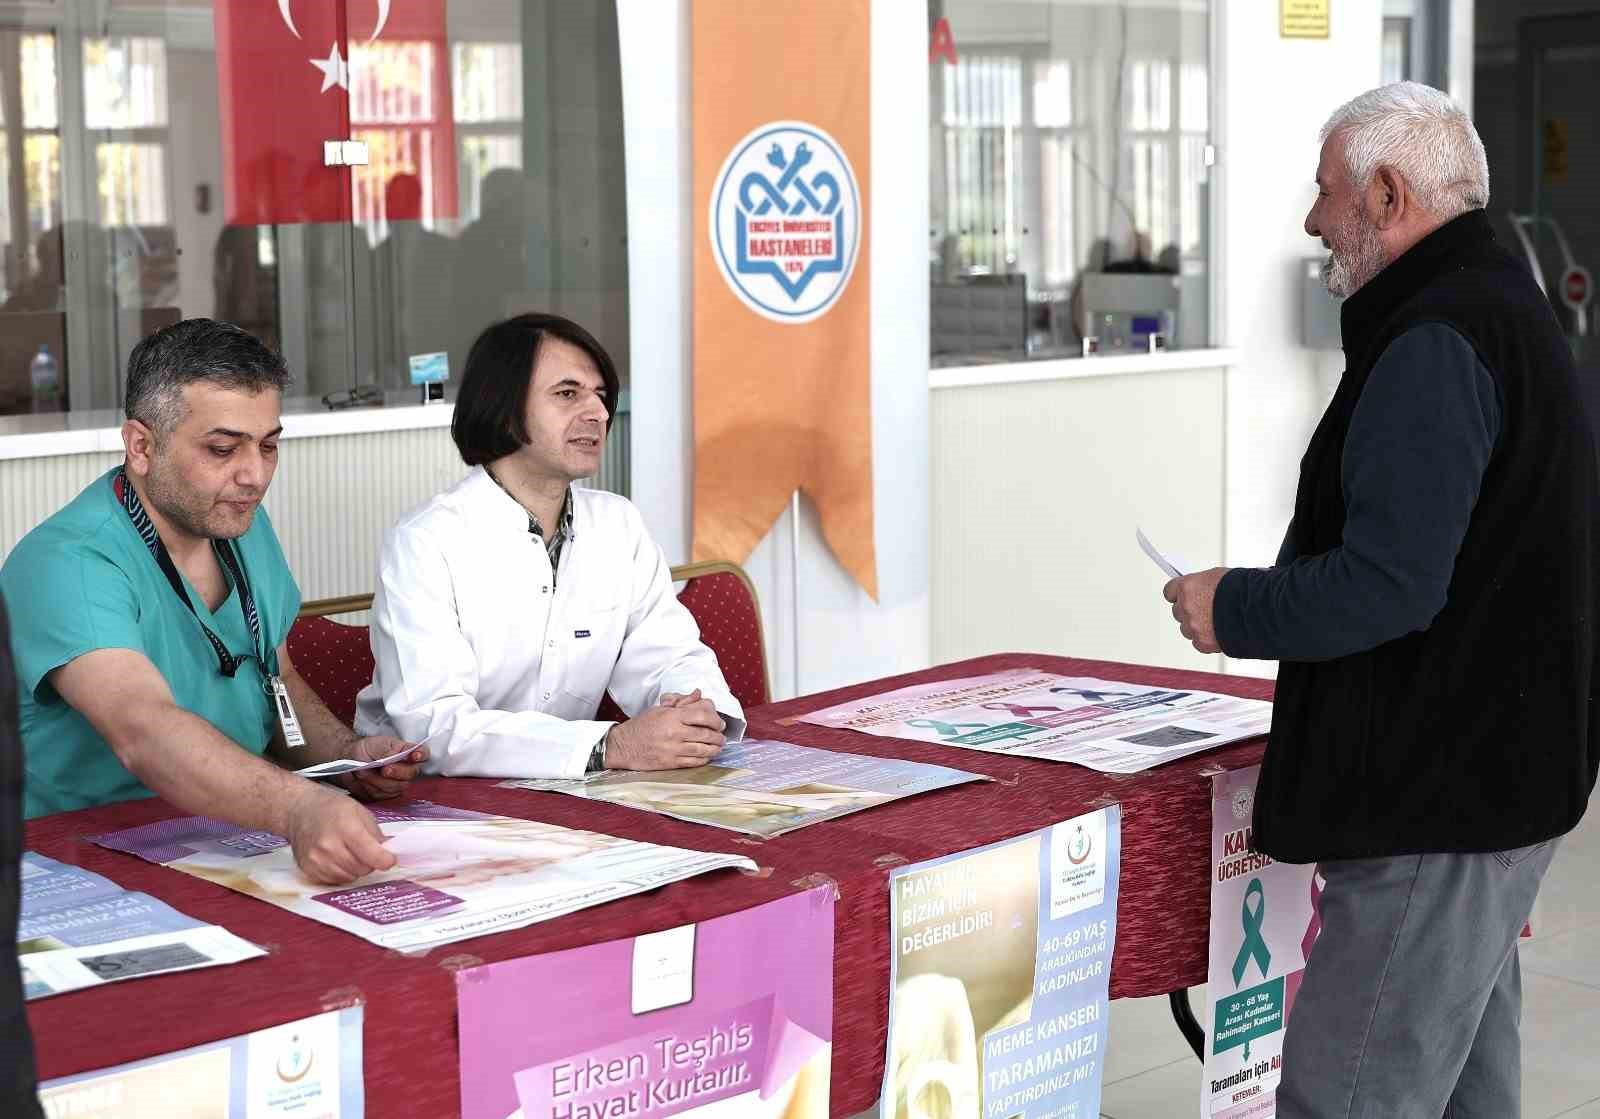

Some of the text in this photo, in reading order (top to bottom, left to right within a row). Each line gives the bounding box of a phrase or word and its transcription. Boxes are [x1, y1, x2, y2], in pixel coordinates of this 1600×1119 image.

[1043, 919, 1107, 952] 40-69 YAŞ
[1039, 960, 1104, 995] KADINLAR
[1230, 1002, 1240, 1013] 30
[552, 1023, 752, 1098] Erken Teşhis
[988, 1026, 1034, 1058] MEME
[988, 1031, 1099, 1093] TARAMANIZI
[1210, 1054, 1281, 1095] Taramaları için Ail
[552, 1060, 750, 1119] Hayat Kurtarır.
